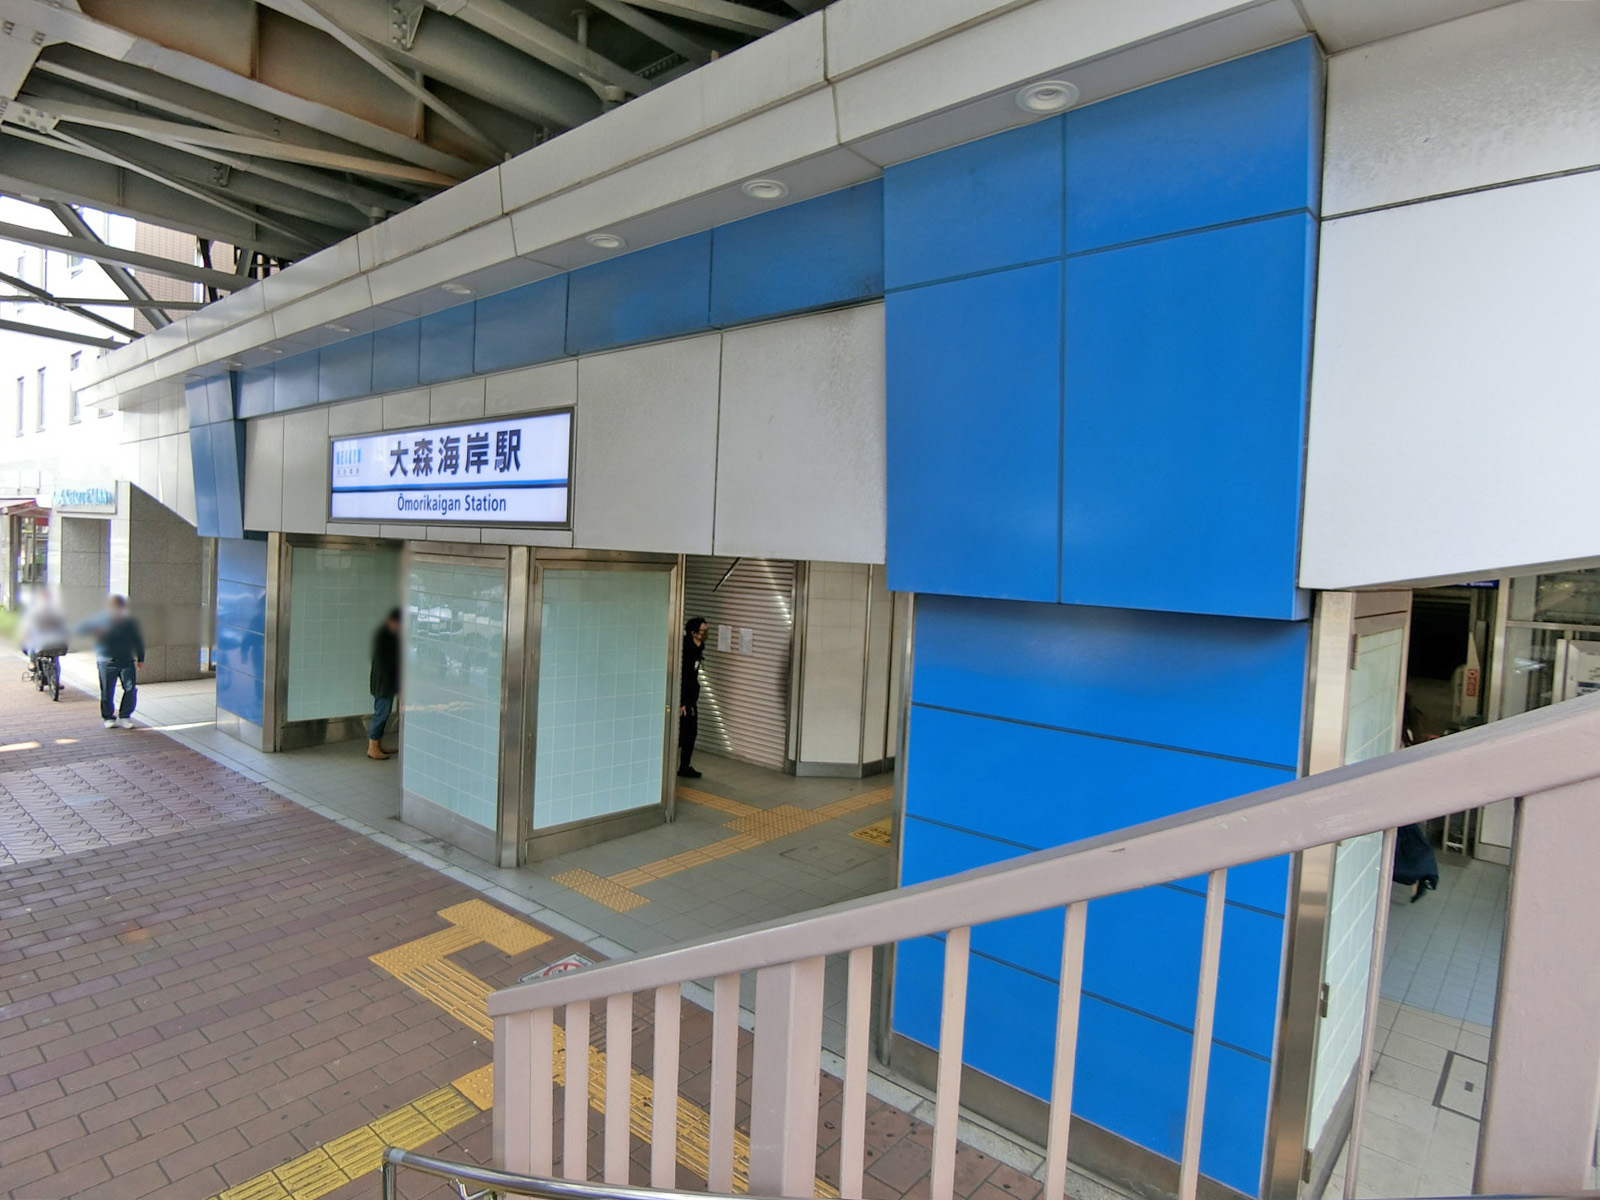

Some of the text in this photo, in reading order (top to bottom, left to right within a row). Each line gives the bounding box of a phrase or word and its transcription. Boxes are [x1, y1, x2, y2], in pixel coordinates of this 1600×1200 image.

[389, 428, 522, 477] 大森海岸駅
[397, 493, 507, 515] Ōmorikaigan Station
